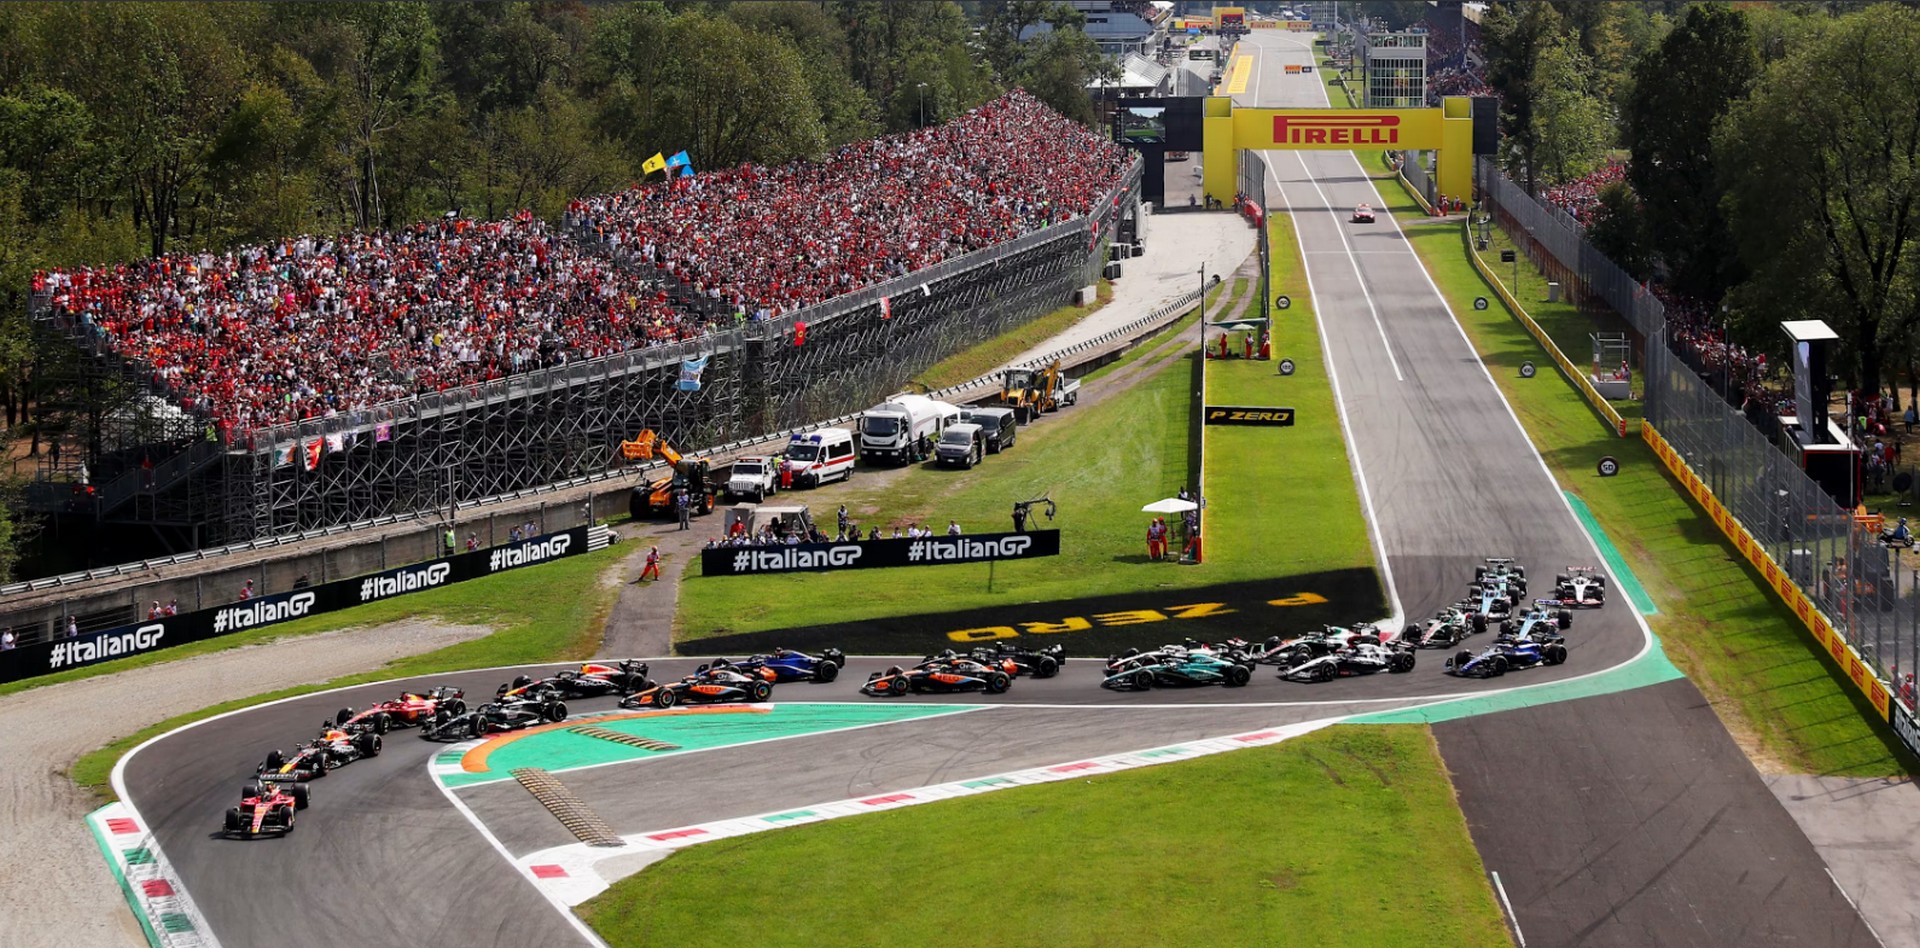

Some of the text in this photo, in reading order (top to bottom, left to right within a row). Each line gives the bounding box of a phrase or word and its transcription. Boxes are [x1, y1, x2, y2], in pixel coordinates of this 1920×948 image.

[1273, 115, 1400, 143] PIRELLI
[1210, 411, 1289, 421] P ZERO
[490, 533, 571, 570] #ItalianGP
[733, 546, 862, 571] #ItalianGP
[908, 535, 1031, 561] #ItalianGP
[360, 562, 450, 600] #ItalianGP
[213, 591, 315, 633] #ItalianGP
[947, 592, 1329, 642] P ZERO
[49, 623, 164, 668] #ItalianGP
